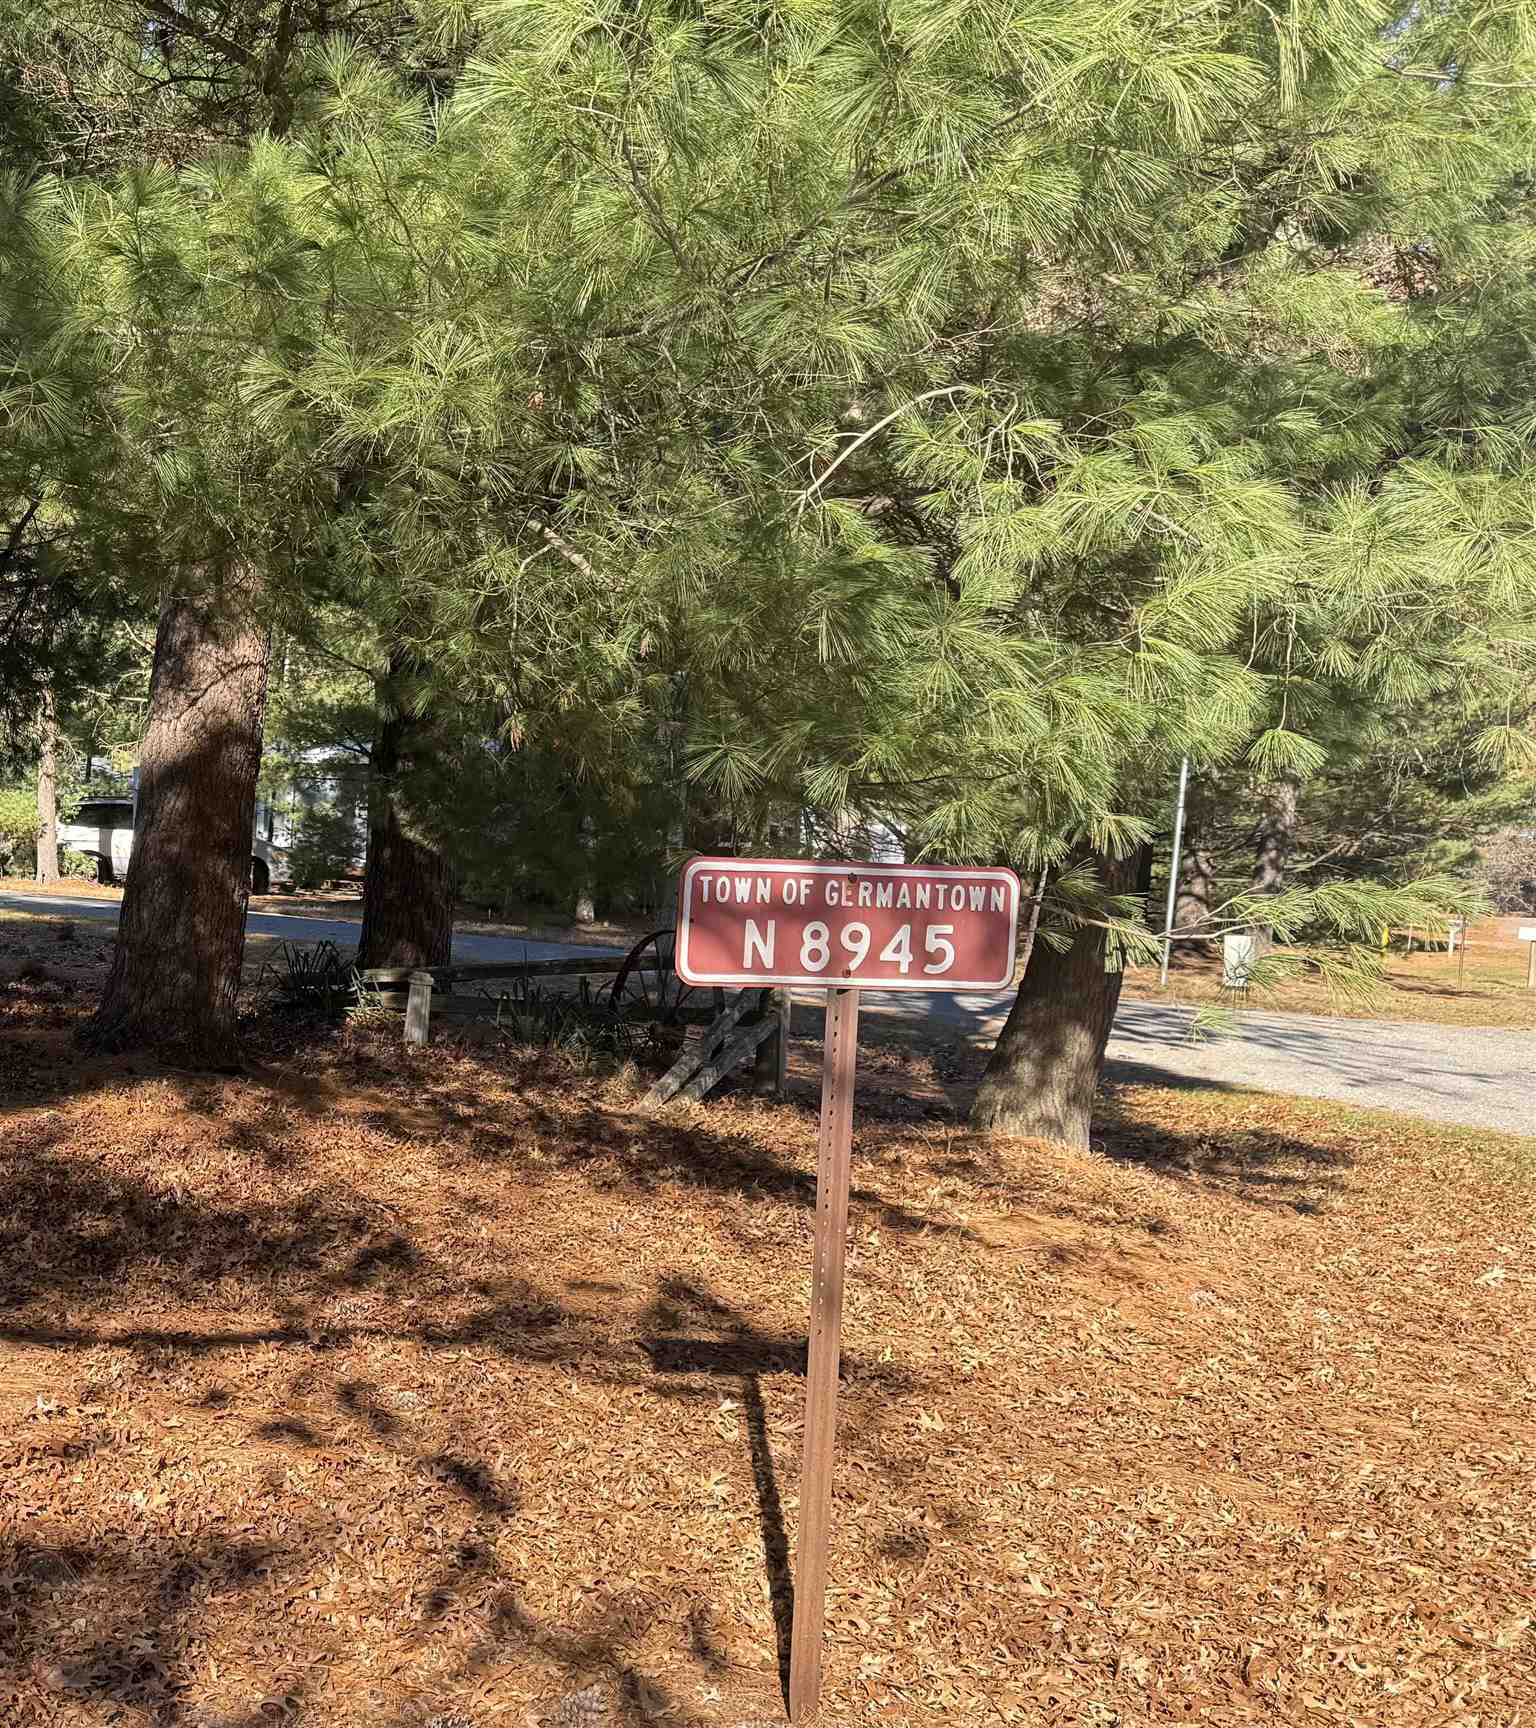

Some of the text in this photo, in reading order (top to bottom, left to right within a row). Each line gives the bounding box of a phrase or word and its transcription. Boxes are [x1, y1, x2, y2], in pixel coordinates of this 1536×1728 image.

[699, 876, 1006, 912] TOWN OF GERMANTOWN
[742, 919, 956, 974] N 8945
